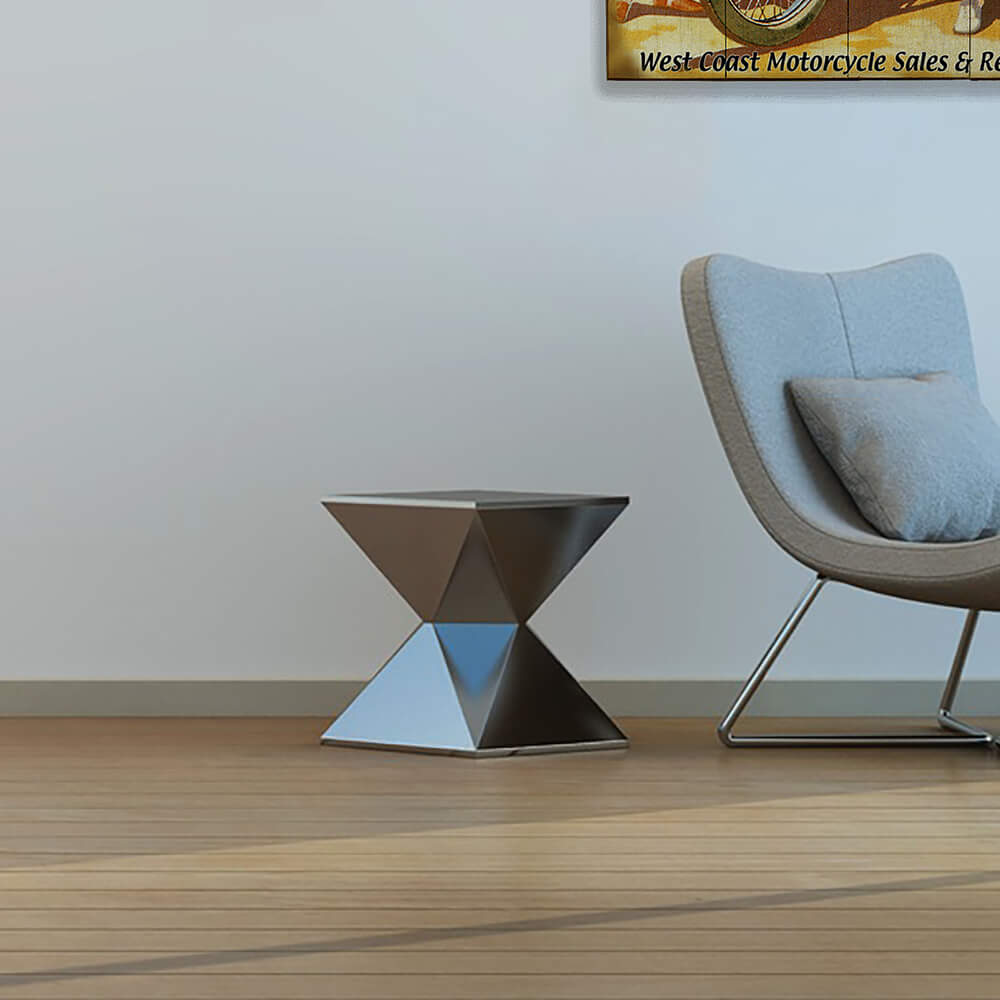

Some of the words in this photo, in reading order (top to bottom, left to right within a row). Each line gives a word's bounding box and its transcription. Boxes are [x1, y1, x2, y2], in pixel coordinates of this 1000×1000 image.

[640, 51, 693, 73] West
[700, 51, 760, 73] Coast
[767, 50, 886, 75] Motorcycle
[894, 50, 949, 73] Sales
[954, 51, 973, 73] &
